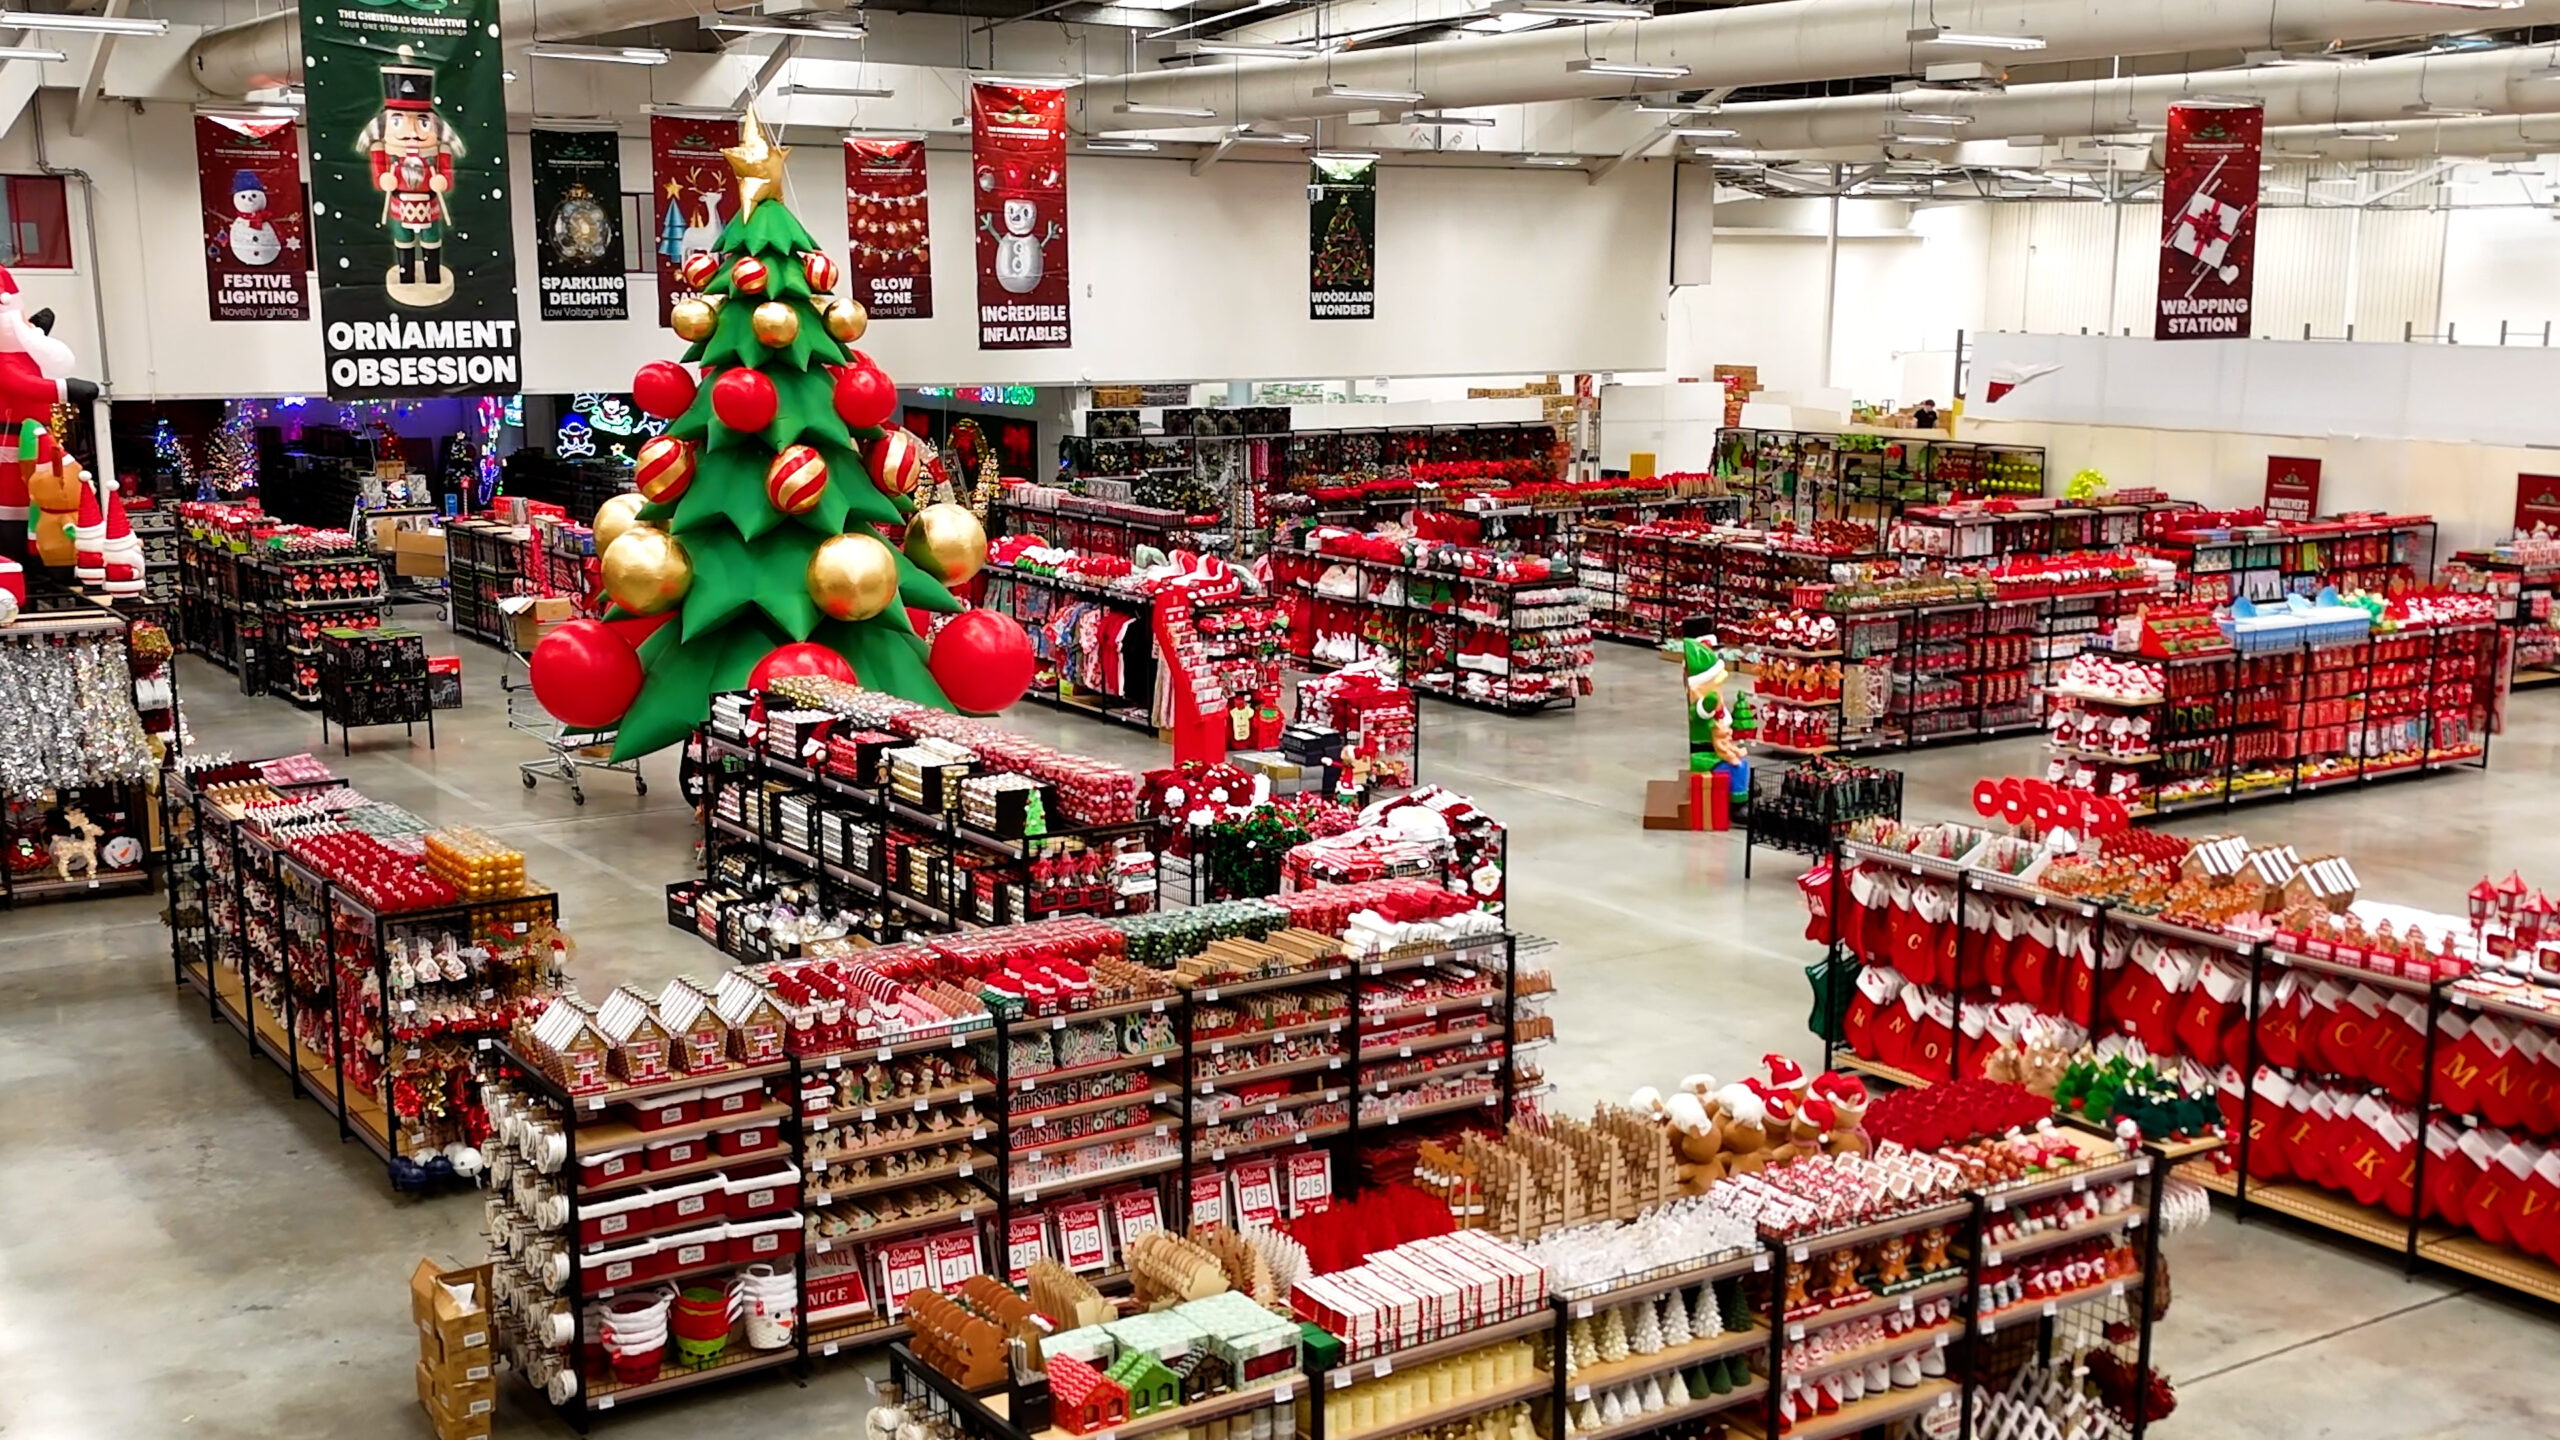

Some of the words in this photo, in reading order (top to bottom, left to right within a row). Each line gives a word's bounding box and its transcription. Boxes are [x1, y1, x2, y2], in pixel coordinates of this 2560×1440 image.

[338, 9, 357, 20] THE
[358, 12, 410, 25] CHRISTMAS
[411, 15, 468, 28] COLLECTIVE
[362, 22, 378, 31] ONE
[380, 24, 399, 33] STOP
[401, 26, 445, 36] CHRISTMAS
[223, 274, 292, 289] FESTIVE
[541, 276, 625, 291] SPARKLING
[870, 277, 913, 291] GLOW
[218, 290, 299, 305] LIGHTING
[549, 291, 619, 306] DELIGHTS
[874, 291, 913, 305] ZONE
[1311, 291, 1374, 303] WOODLAND
[220, 307, 258, 318] Novelty
[260, 307, 299, 319] Lighting
[543, 307, 563, 317] Low
[563, 307, 600, 319] Voltage
[600, 306, 626, 319] Lights
[870, 306, 891, 316] Rope
[892, 305, 917, 317] Lights
[981, 305, 1067, 322] INCREDIBLE
[1314, 304, 1371, 316] WONDERS
[2161, 298, 2248, 316] WRAPPING
[2168, 316, 2238, 334] STATION
[327, 320, 516, 350] ORNAMENT
[983, 326, 1068, 343] INFLATABLES
[331, 355, 517, 388] OBSESSION
[2335, 1021, 2362, 1047] C
[2441, 1051, 2479, 1090] M
[2485, 1065, 2520, 1097] N
[1009, 1116, 1081, 1150] CHRISTMS
[1296, 1158, 1323, 1175] Santa
[2353, 1147, 2385, 1180] K
[1239, 1167, 1267, 1185] Santa
[1191, 1182, 1218, 1199] Santa
[1121, 1199, 1151, 1216] Santa
[1066, 1210, 1096, 1228] Santa
[1009, 1224, 1038, 1242] Santa
[940, 1237, 971, 1256] Santa
[889, 1248, 922, 1267] Santa
[808, 1286, 849, 1307] NICE
